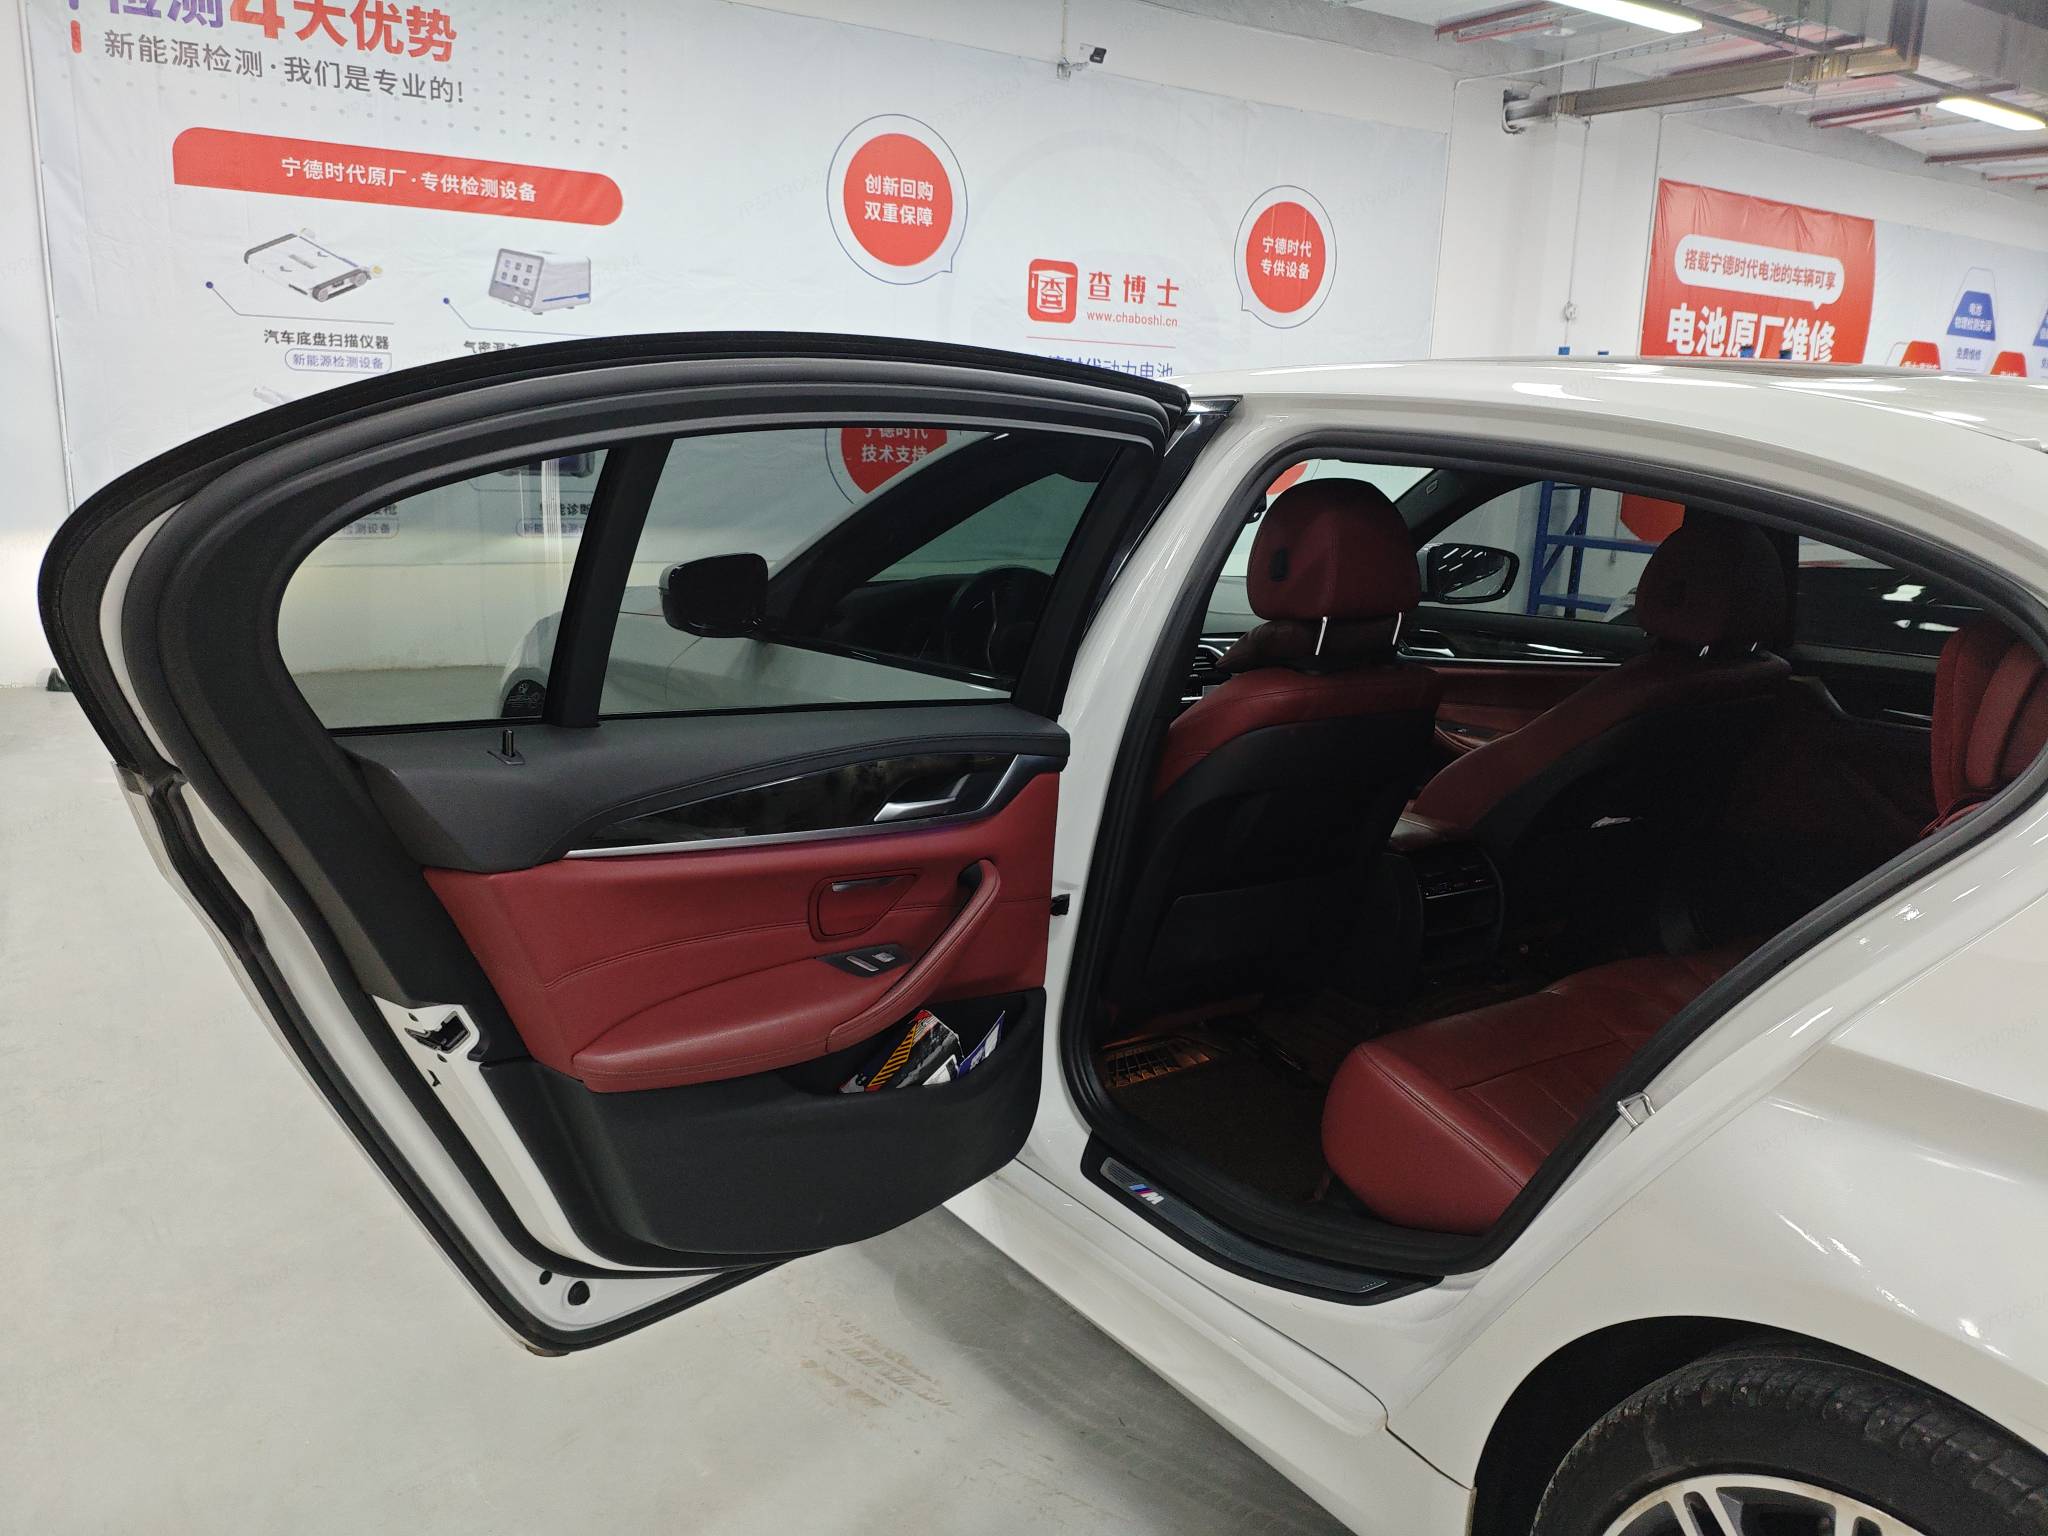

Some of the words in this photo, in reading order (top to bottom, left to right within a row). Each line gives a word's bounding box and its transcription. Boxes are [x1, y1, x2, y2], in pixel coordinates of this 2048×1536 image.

[281, 157, 537, 202] 宁德时代原厂·专供检测设备
[865, 174, 933, 201] 创新回购
[864, 201, 933, 227] 双重保障
[1262, 236, 1312, 257] 宁德时代
[1261, 259, 1310, 279] 专供设备
[1684, 248, 1837, 291] 搭载宁德时代电池的车辆可享
[1087, 311, 1179, 328] www.chaboshi.cn
[264, 329, 390, 351] 汽车底盘扫描仪器
[1666, 302, 1836, 362] 电池原厂维修
[293, 353, 384, 370] 新能源检测设备
[861, 444, 929, 464] 技术支持
